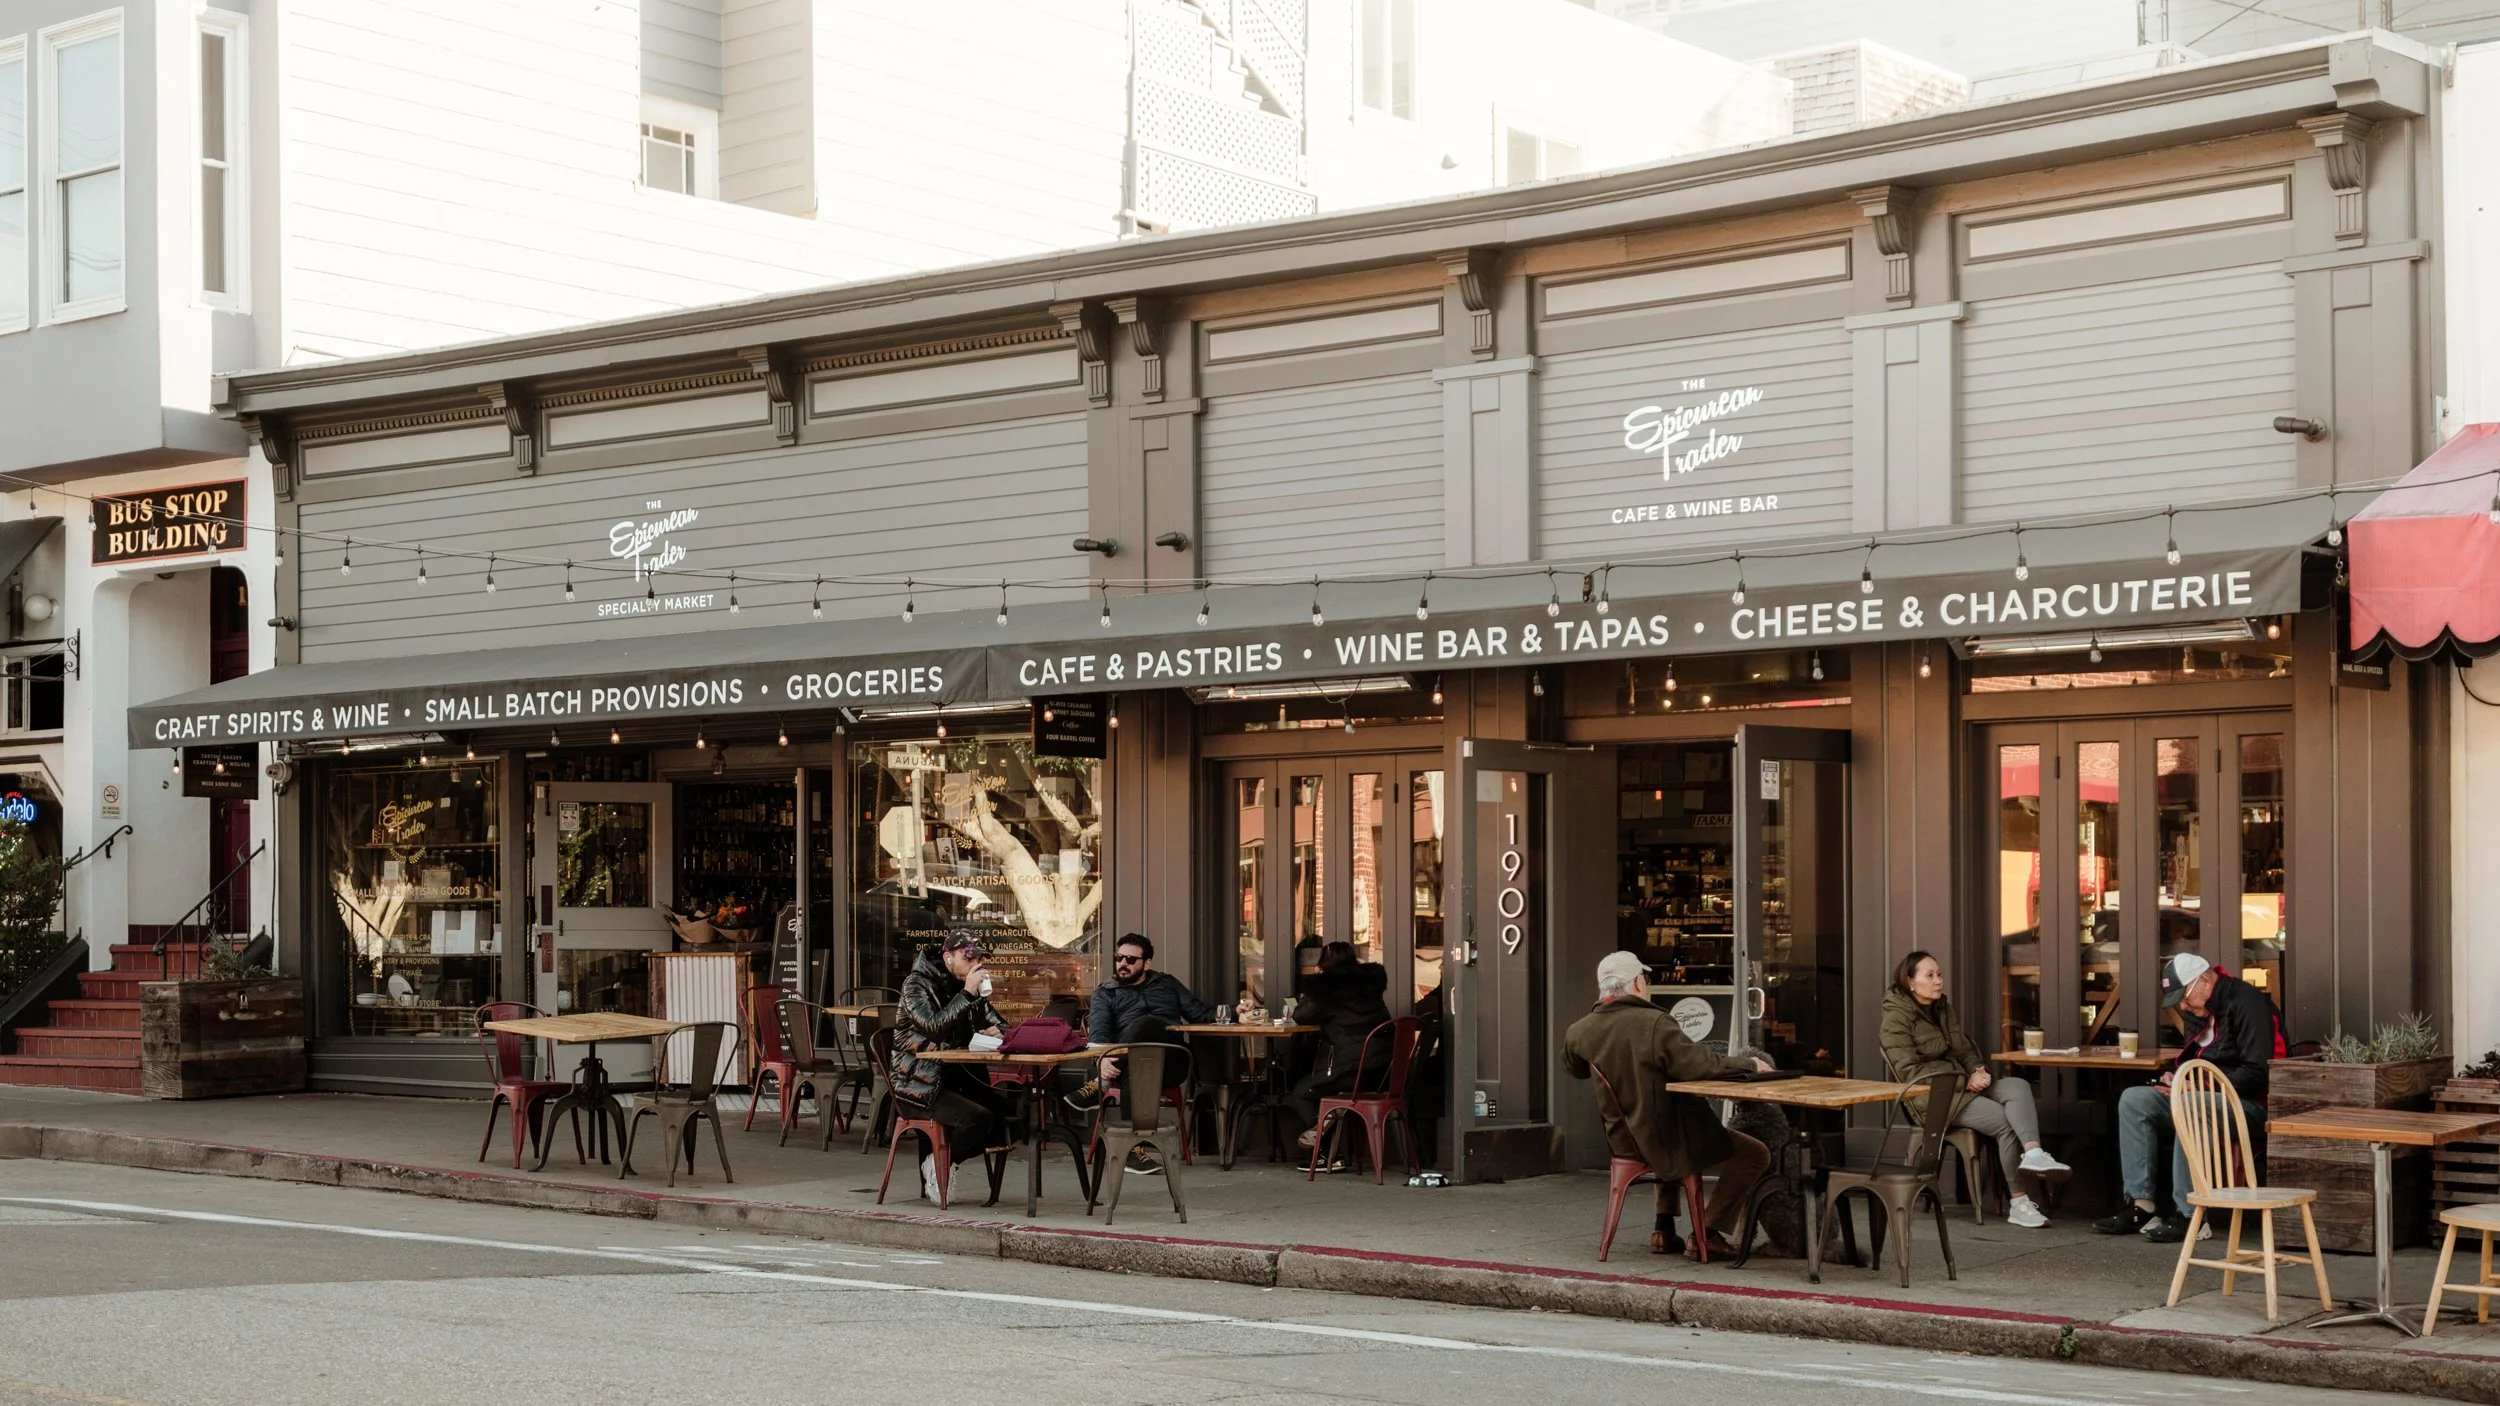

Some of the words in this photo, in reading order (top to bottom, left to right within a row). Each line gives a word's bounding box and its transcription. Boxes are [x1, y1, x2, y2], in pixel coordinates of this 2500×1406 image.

[1682, 378, 1706, 391] THE
[1623, 387, 1764, 450] Epicurean
[1644, 428, 1743, 481] Trader
[109, 498, 153, 526] BUS
[164, 489, 229, 519] STOP
[646, 500, 662, 510] THE
[1612, 506, 1659, 524] CAFE
[1665, 504, 1677, 519] &
[1683, 499, 1733, 518] WINE
[1740, 495, 1779, 513] BAR
[108, 520, 228, 556] BUILDING
[609, 508, 699, 557] Epicurean
[624, 540, 687, 582] Trader
[665, 594, 714, 610] MARKET
[1730, 598, 1884, 640] CHEESE
[1899, 596, 1924, 628] &
[1939, 571, 2253, 627] CHARCUTERIE
[1334, 631, 1424, 665] WINE
[1438, 626, 1508, 659] BAR
[1520, 623, 1542, 654] &
[1554, 614, 1669, 651] TAPAS
[1019, 655, 1096, 686] CAFE
[1106, 653, 1125, 681] &
[1136, 642, 1282, 679] PASTRIES
[425, 695, 500, 723] SMALL
[505, 689, 581, 717] BATCH
[591, 678, 743, 713] PROVISIONS
[786, 666, 943, 700] GROCERIES
[154, 713, 220, 741] CRAFT
[227, 709, 304, 736] SPIRITS
[311, 708, 324, 731] &
[332, 702, 389, 729] WINE
[1046, 733, 1059, 741] FOUR
[1060, 734, 1078, 742] BARREL
[382, 800, 434, 827] Epicurean
[391, 818, 427, 843] Trader
[440, 886, 471, 896] GOODS
[932, 875, 966, 886] BATCH
[1018, 874, 1055, 885] GOODS
[1499, 814, 1524, 955] 1909
[906, 930, 949, 938] FARMSTEAD
[996, 942, 1034, 950] VINEGARS
